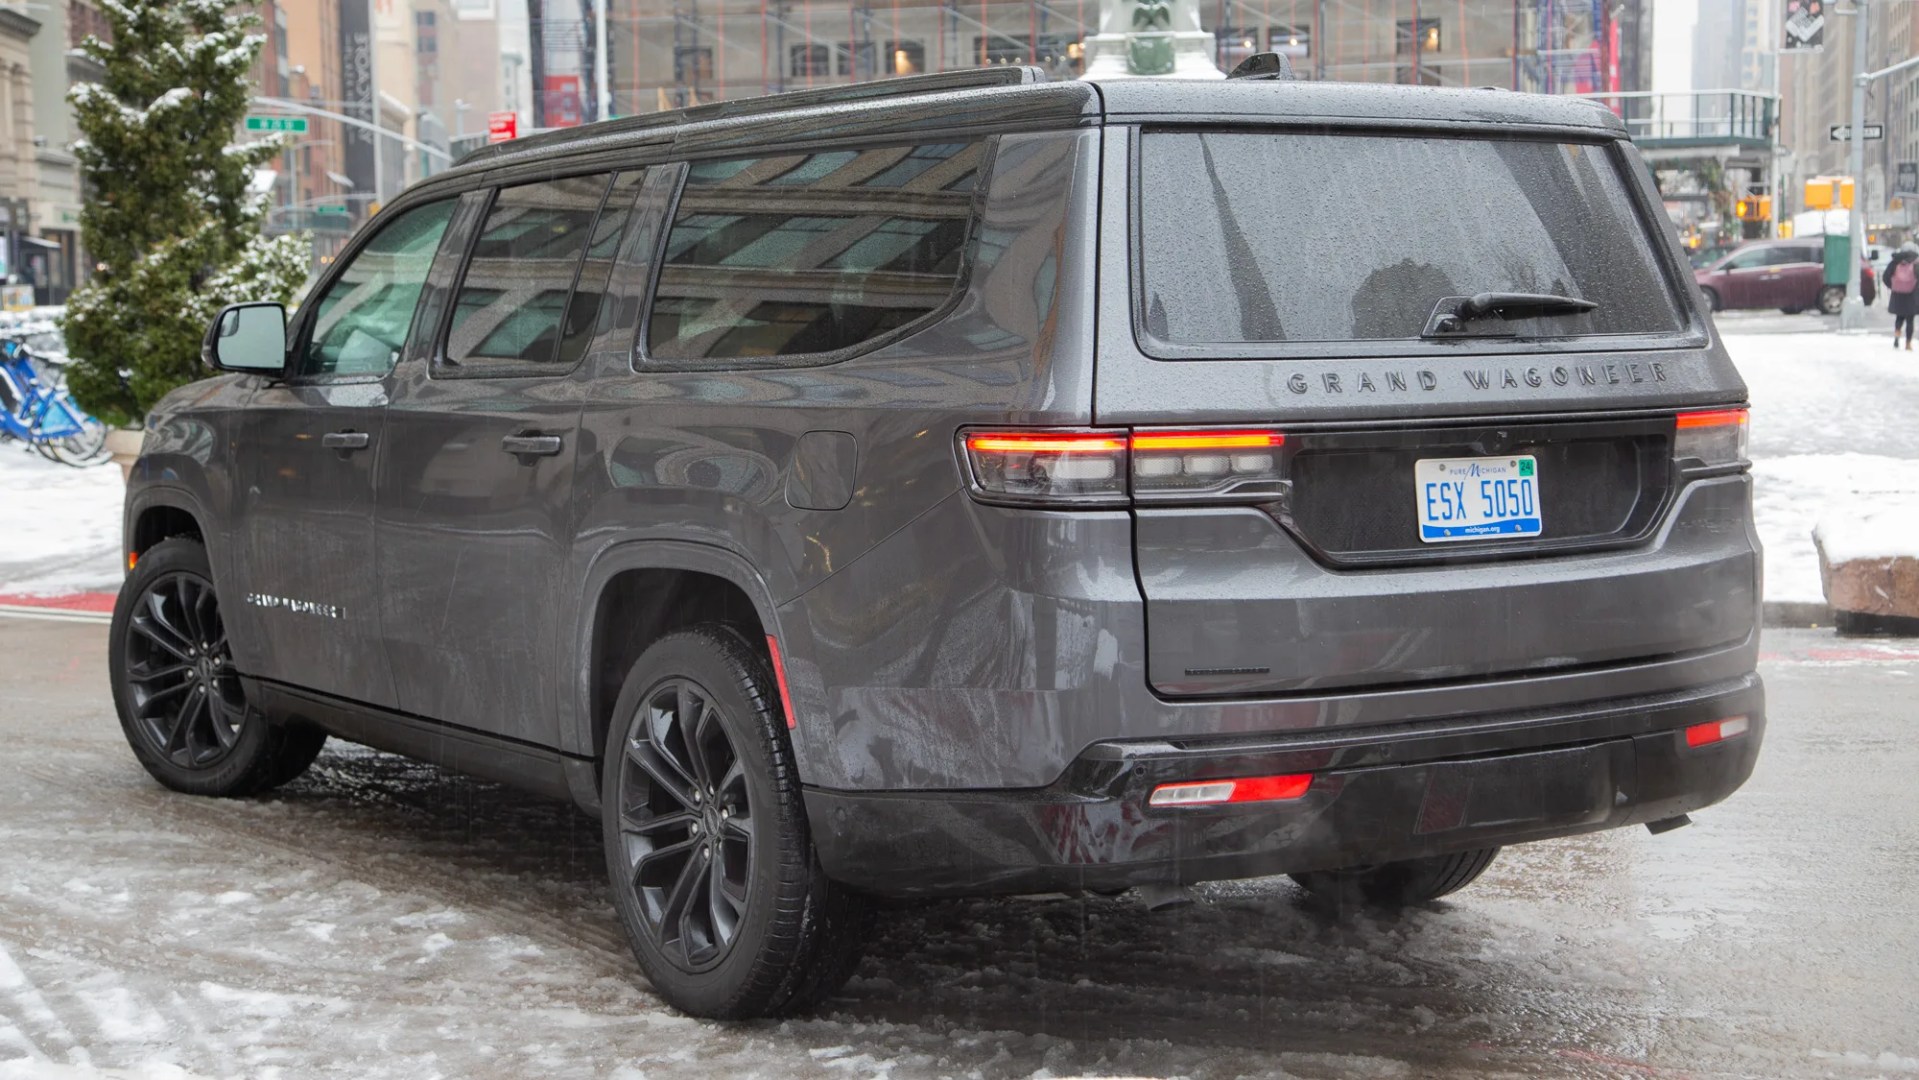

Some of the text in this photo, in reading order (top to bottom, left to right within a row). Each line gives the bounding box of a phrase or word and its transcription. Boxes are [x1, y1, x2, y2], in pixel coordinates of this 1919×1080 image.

[1286, 361, 1668, 394] GRAND WAGONEER
[1449, 467, 1466, 475] PURE
[1520, 461, 1532, 472] 24
[1425, 479, 1533, 521] ESX 5050
[1464, 525, 1501, 535] michigan.org
